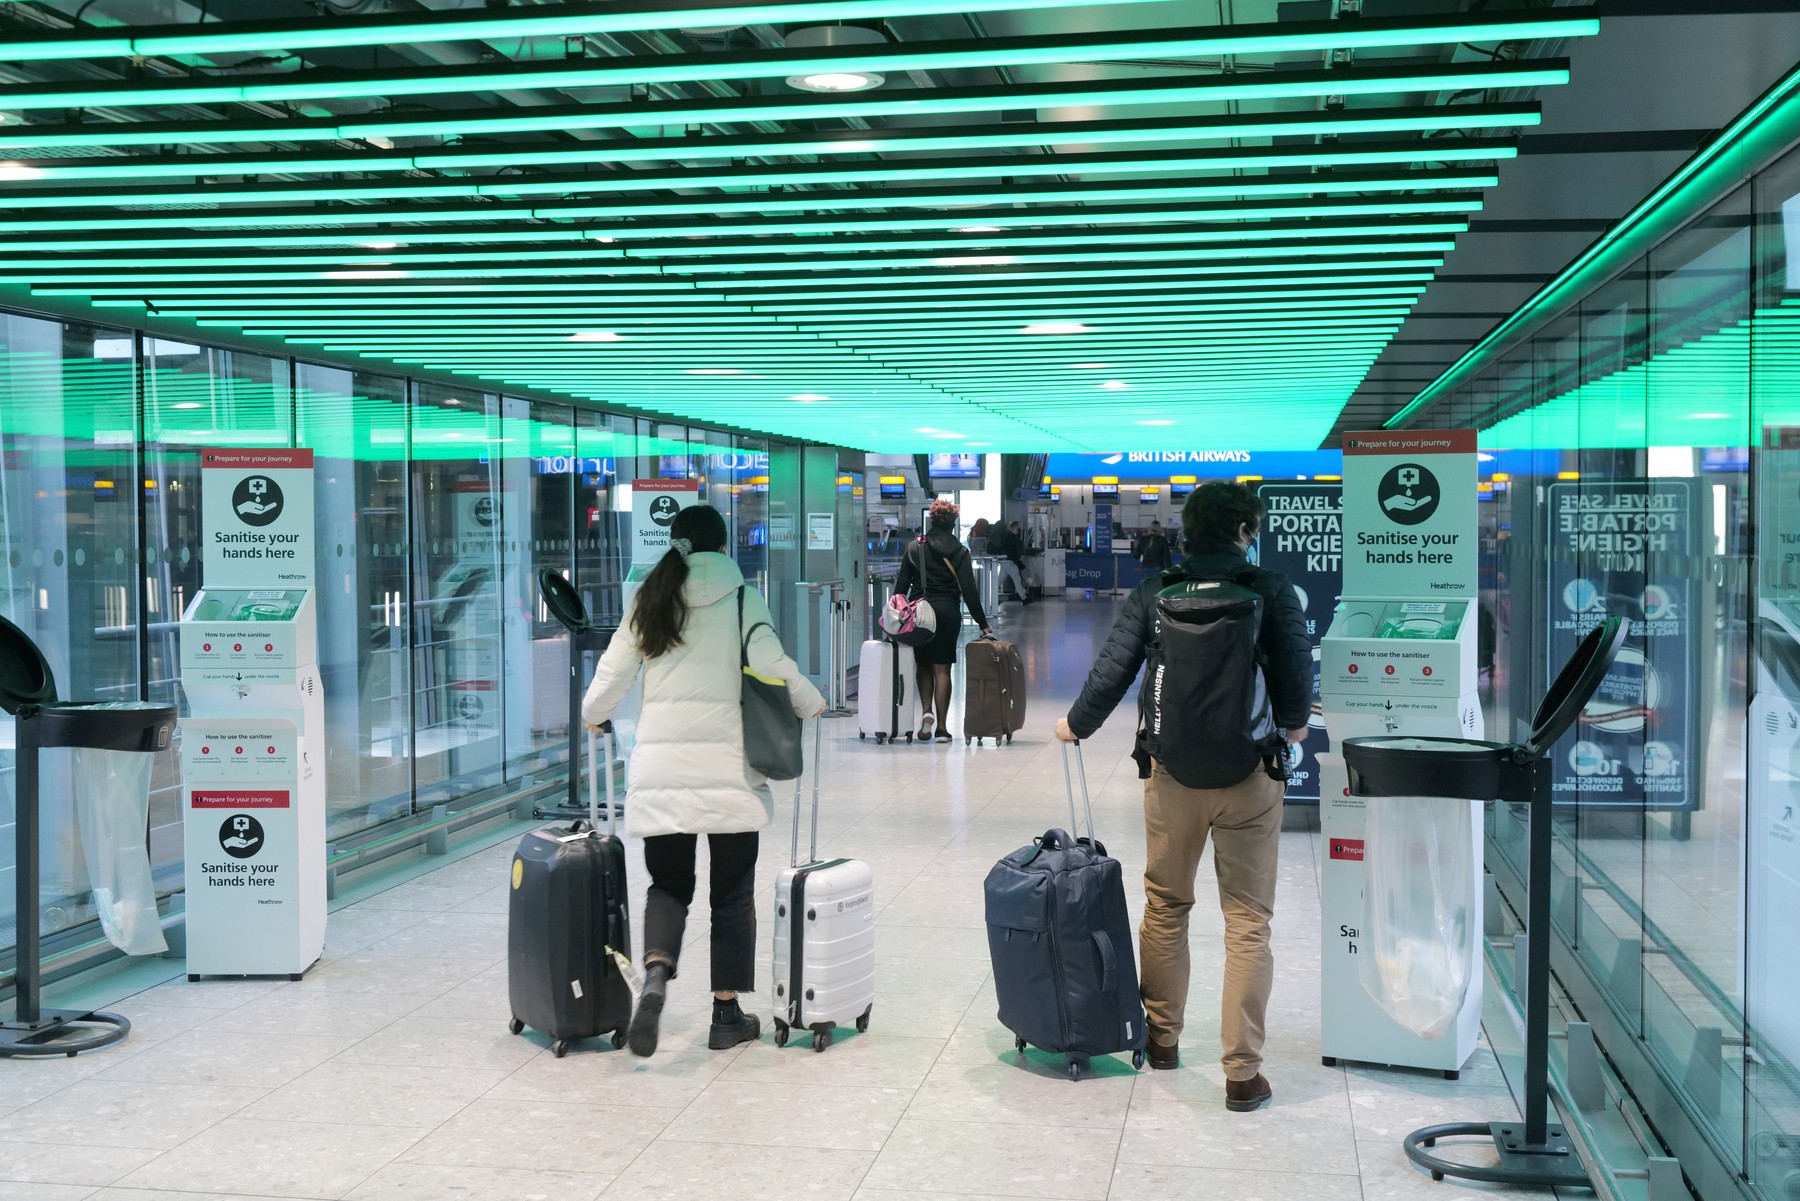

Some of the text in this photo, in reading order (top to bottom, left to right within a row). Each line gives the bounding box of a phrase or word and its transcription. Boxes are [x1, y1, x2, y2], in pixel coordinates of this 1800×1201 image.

[1420, 439, 1451, 448] journey
[1128, 450, 1251, 462] BRITISH AIRWAYS
[1268, 496, 1334, 510] TRAVEL
[1269, 515, 1342, 532] PORTA
[215, 532, 299, 545] Sanitise your
[1278, 535, 1342, 552] HYGIE
[1357, 531, 1459, 547] Sanitise your
[223, 548, 295, 558] hands here
[1366, 550, 1453, 564] hands here
[1307, 554, 1342, 572] KIT
[1080, 569, 1101, 578] Drop
[201, 863, 278, 875] Sanitise your
[209, 876, 275, 886] hands here
